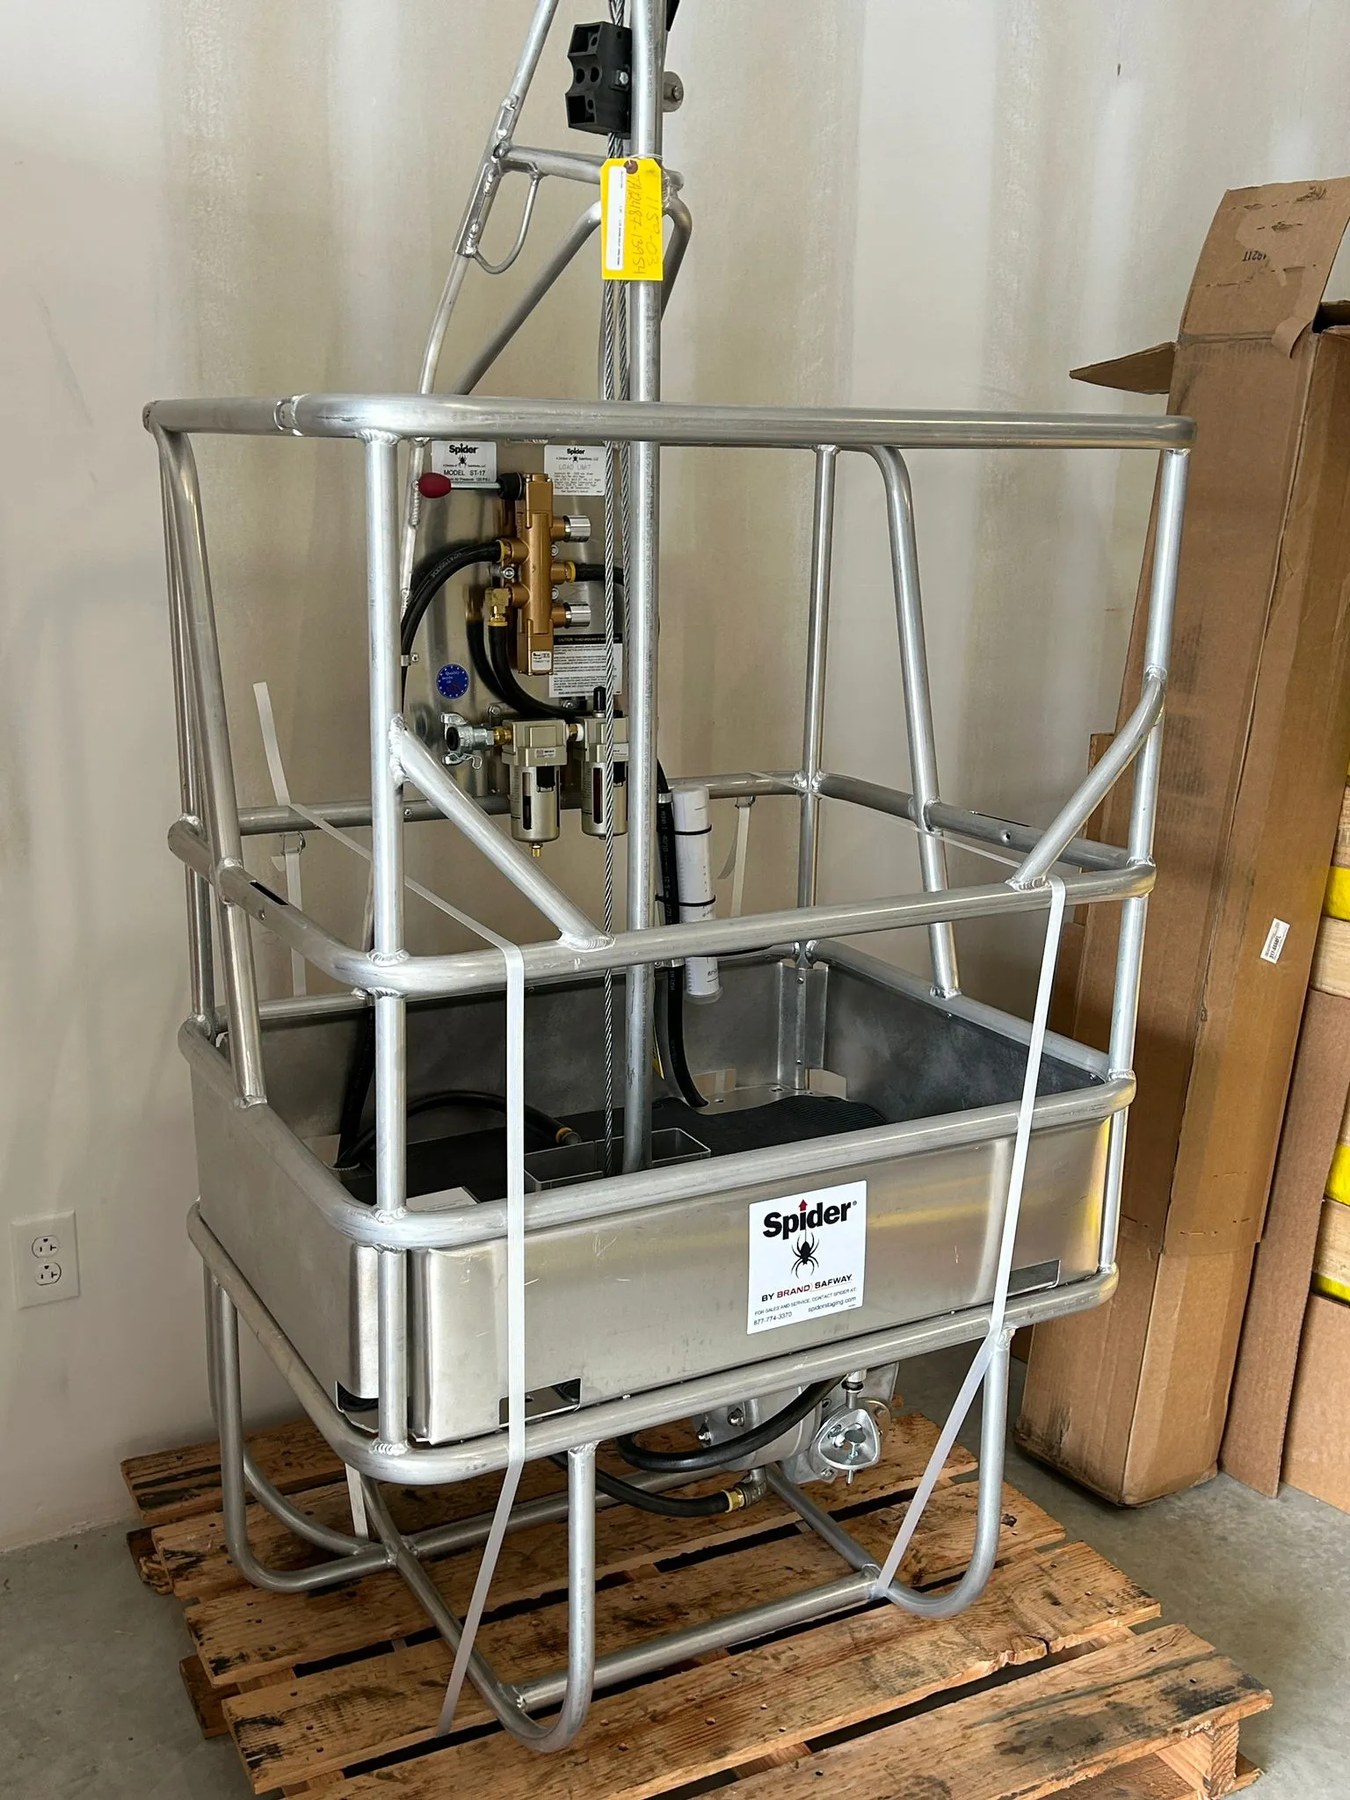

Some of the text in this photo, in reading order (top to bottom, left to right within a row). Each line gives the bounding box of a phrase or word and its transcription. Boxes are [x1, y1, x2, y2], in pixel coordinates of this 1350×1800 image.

[449, 443, 479, 455] Spider
[567, 447, 585, 455] Spider
[763, 1200, 852, 1240] Spider
[761, 1274, 853, 1302] BY BRAND SAFWAY
[765, 1305, 780, 1313] SALES
[811, 1293, 833, 1302] CONTACT
[833, 1288, 850, 1297] SPIDER
[753, 1311, 793, 1326] 877-774-3370
